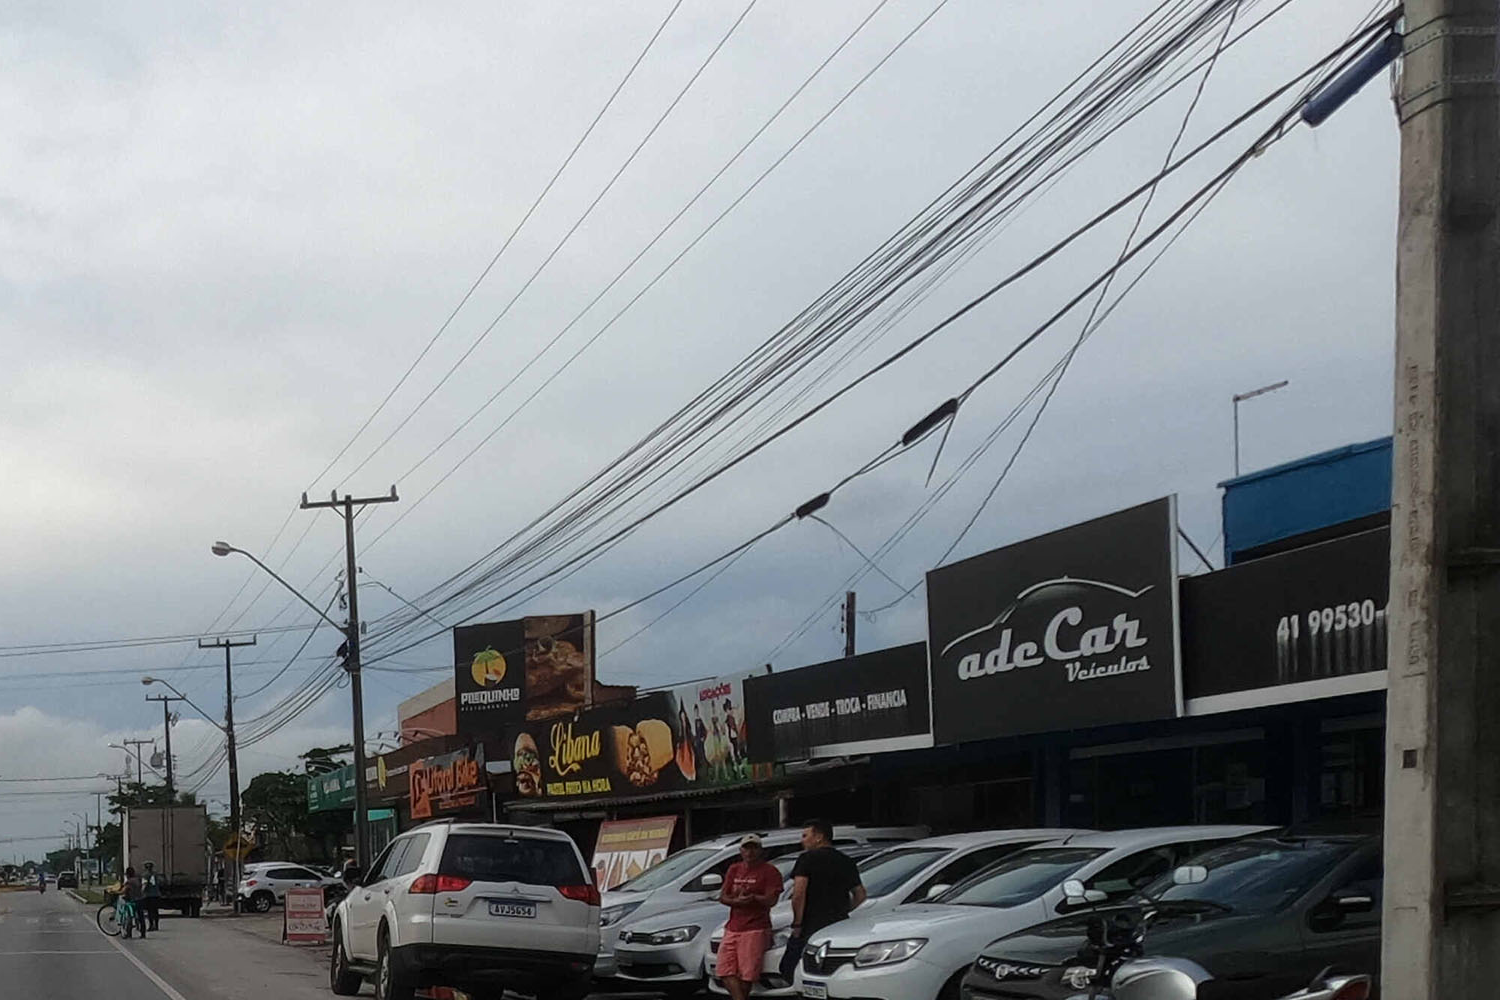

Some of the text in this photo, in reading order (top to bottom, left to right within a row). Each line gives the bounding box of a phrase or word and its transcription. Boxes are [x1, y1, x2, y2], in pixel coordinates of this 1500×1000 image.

[1276, 599, 1388, 642] 41 99530-
[1065, 655, 1150, 682] Veículos
[835, 697, 861, 715] TROCA
[866, 689, 908, 711] FINANCIA
